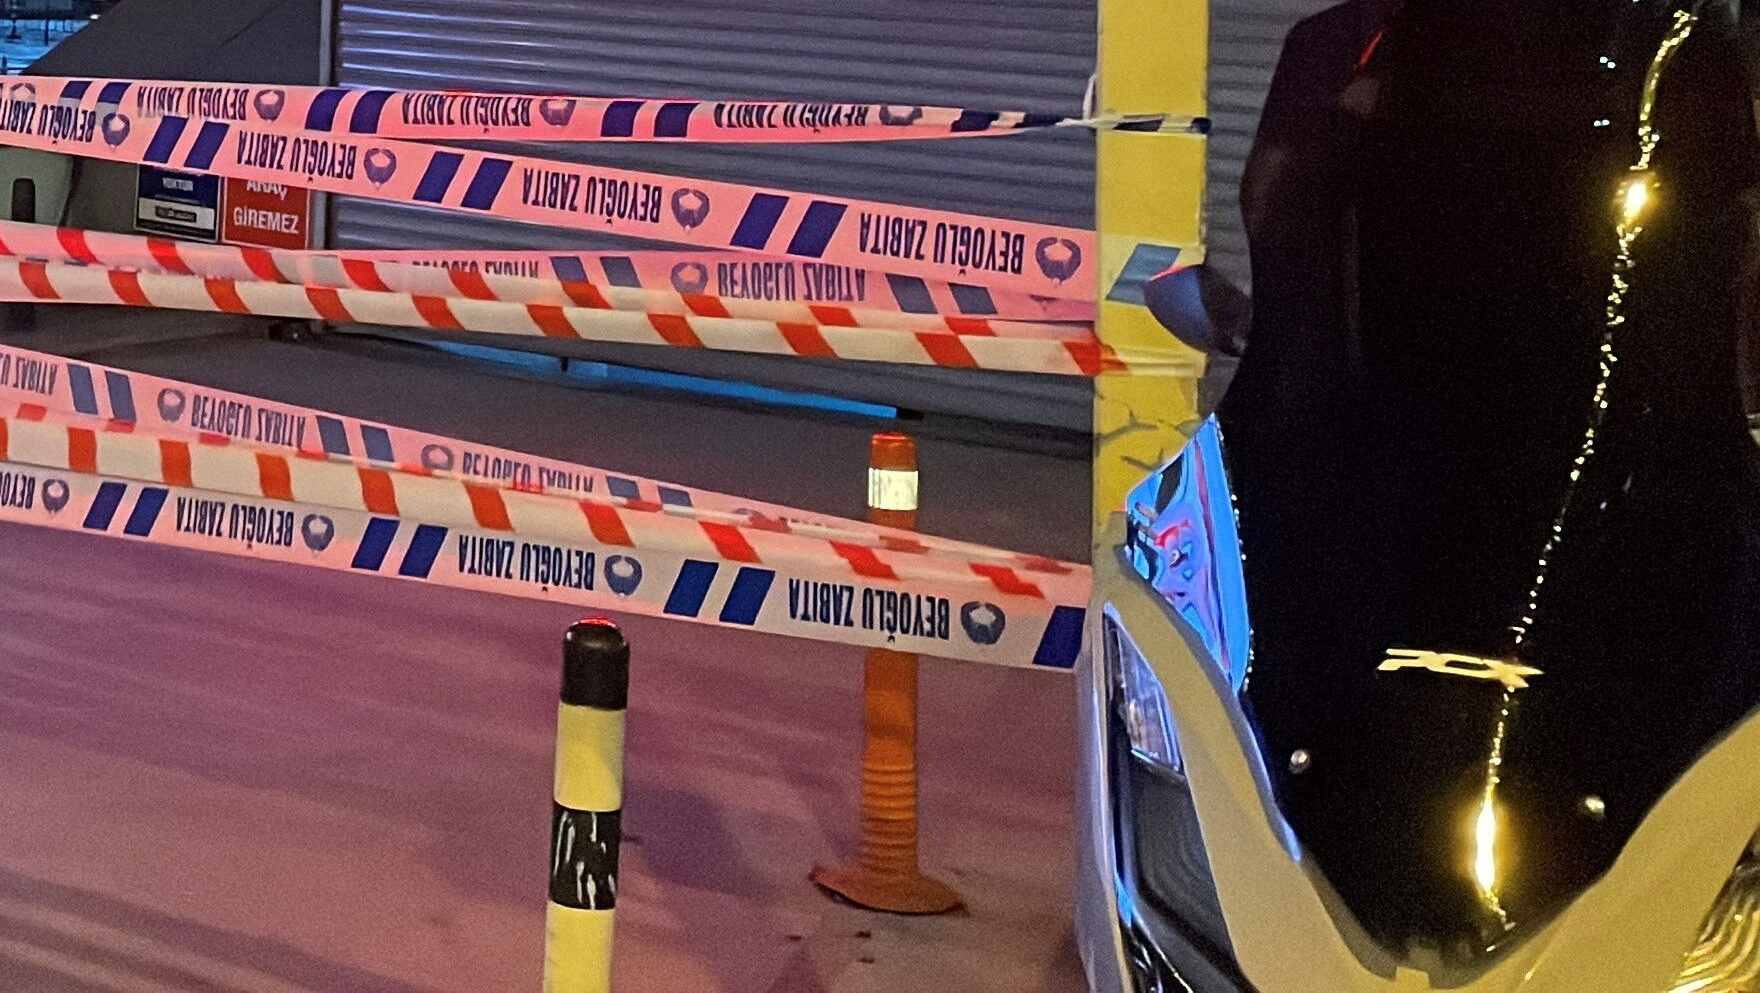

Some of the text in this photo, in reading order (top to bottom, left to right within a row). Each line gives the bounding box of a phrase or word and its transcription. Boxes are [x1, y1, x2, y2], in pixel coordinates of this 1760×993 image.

[522, 168, 581, 211] ZABITA
[859, 212, 1025, 277] BEYOĞLU ZABITA
[458, 534, 516, 580] ZABITA
[788, 578, 951, 644] BEYOĞLU ZABITA
